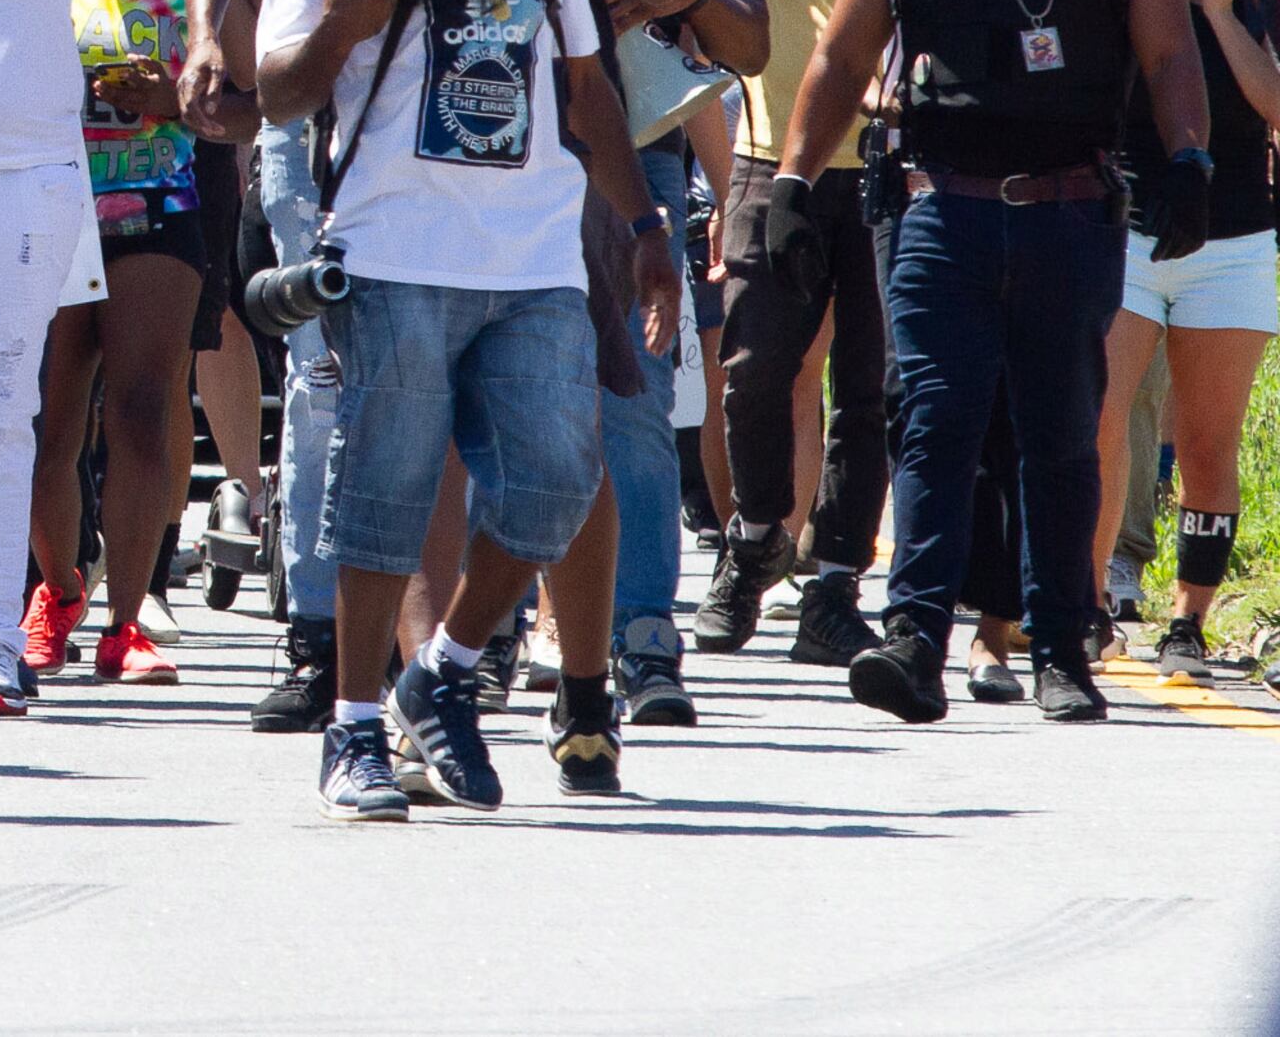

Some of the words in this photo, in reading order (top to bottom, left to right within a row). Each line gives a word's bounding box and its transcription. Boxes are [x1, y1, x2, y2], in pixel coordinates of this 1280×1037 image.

[77, 8, 188, 64] ACK
[444, 20, 528, 45] adidas
[452, 97, 478, 110] THE
[480, 102, 516, 114] BRAND
[1183, 512, 1231, 538] BLM
